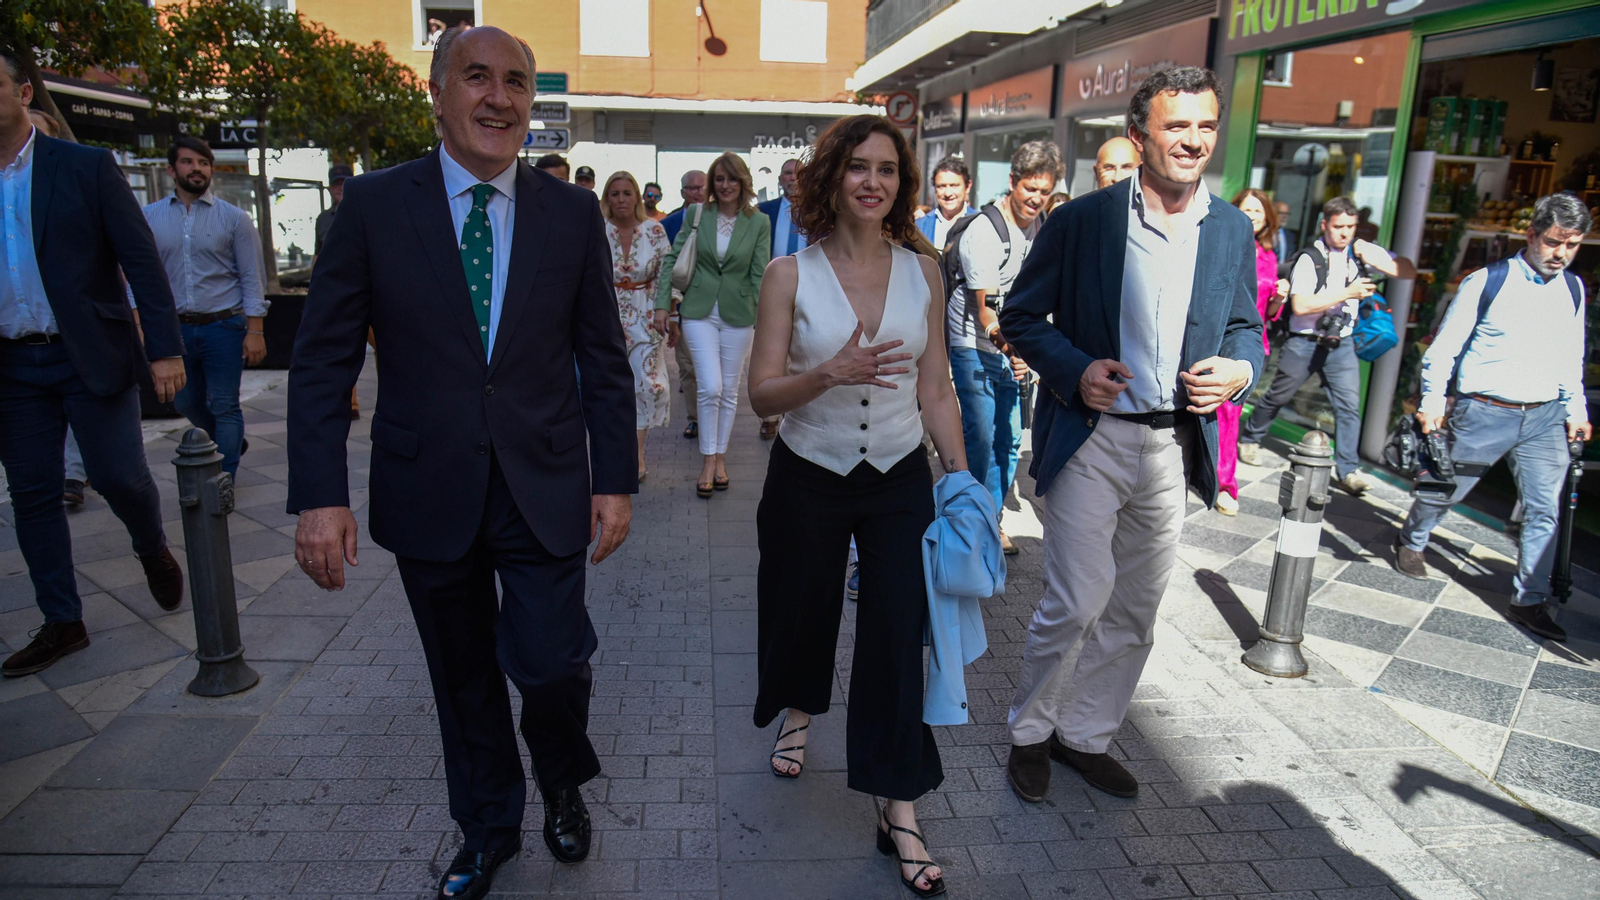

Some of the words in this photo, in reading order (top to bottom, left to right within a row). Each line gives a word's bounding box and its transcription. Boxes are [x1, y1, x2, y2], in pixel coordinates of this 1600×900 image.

[1228, 0, 1378, 39] FRUT
[1092, 60, 1130, 97] Aural
[93, 107, 111, 118] TAPAS
[115, 110, 134, 121] COPAS
[220, 128, 239, 142] LA
